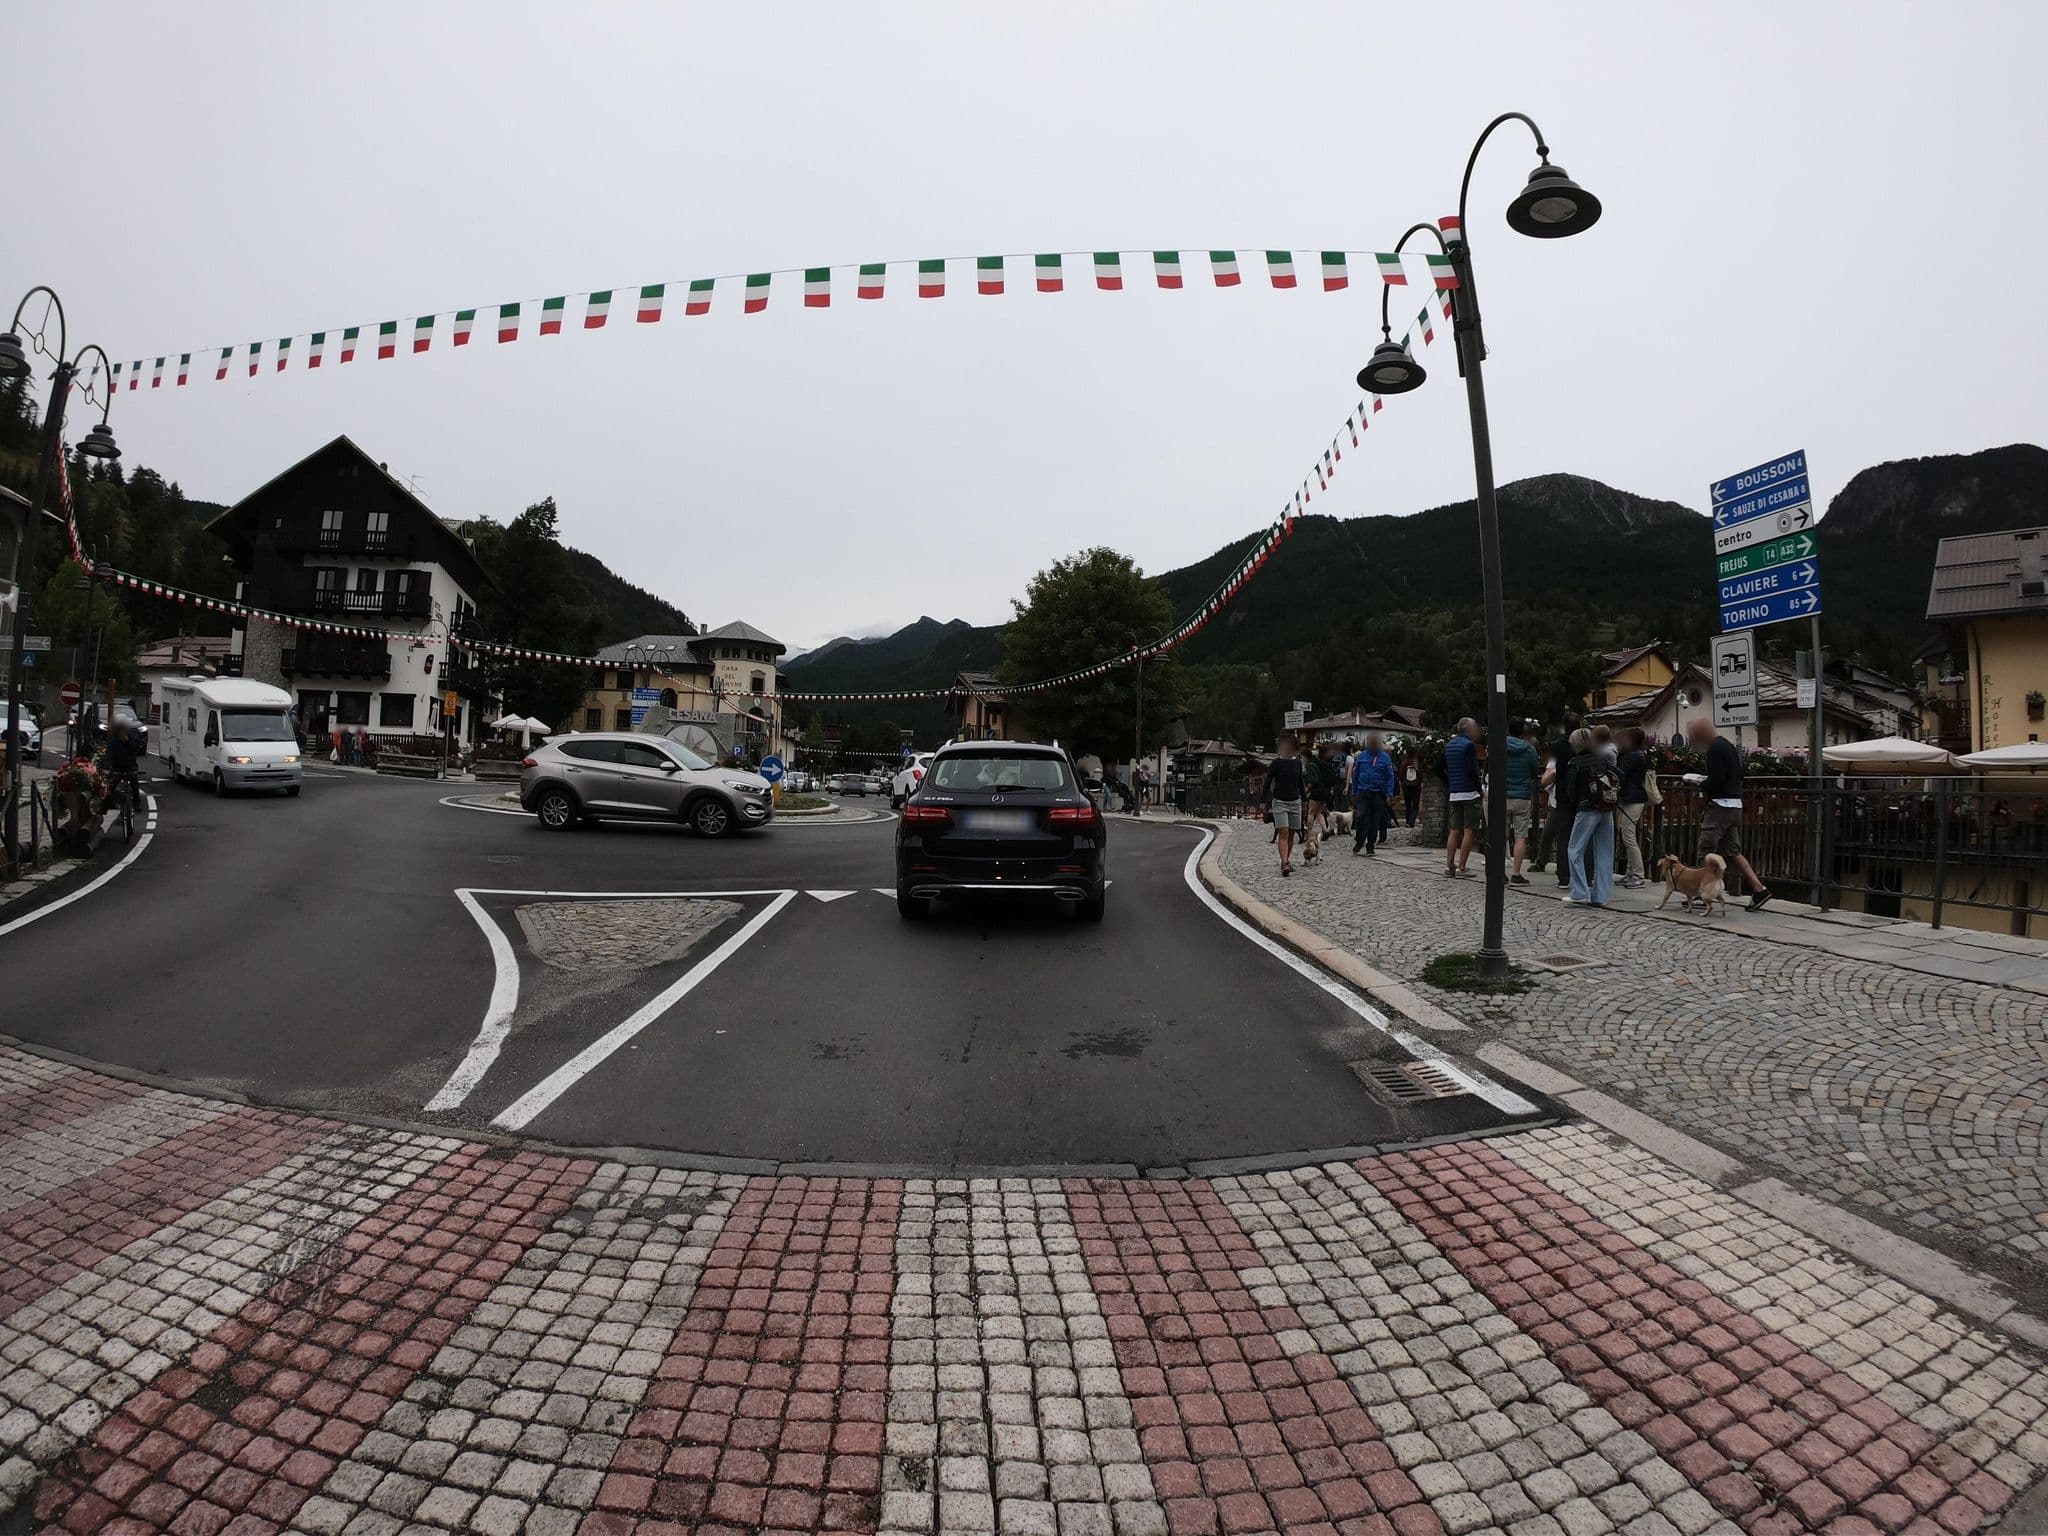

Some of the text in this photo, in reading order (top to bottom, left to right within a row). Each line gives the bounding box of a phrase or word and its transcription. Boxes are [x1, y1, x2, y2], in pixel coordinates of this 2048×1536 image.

[1736, 458, 1803, 490] BOUSSON 4
[1732, 484, 1807, 518] SAUZE DI CESANA 8
[1718, 530, 1752, 548] centro
[1720, 544, 1795, 574] FREJUS T4 A32
[1721, 571, 1798, 599] CLAVIERE 6
[1723, 599, 1800, 625] TORINO 85
[667, 707, 717, 720] CESANA
[734, 745, 742, 755] P
